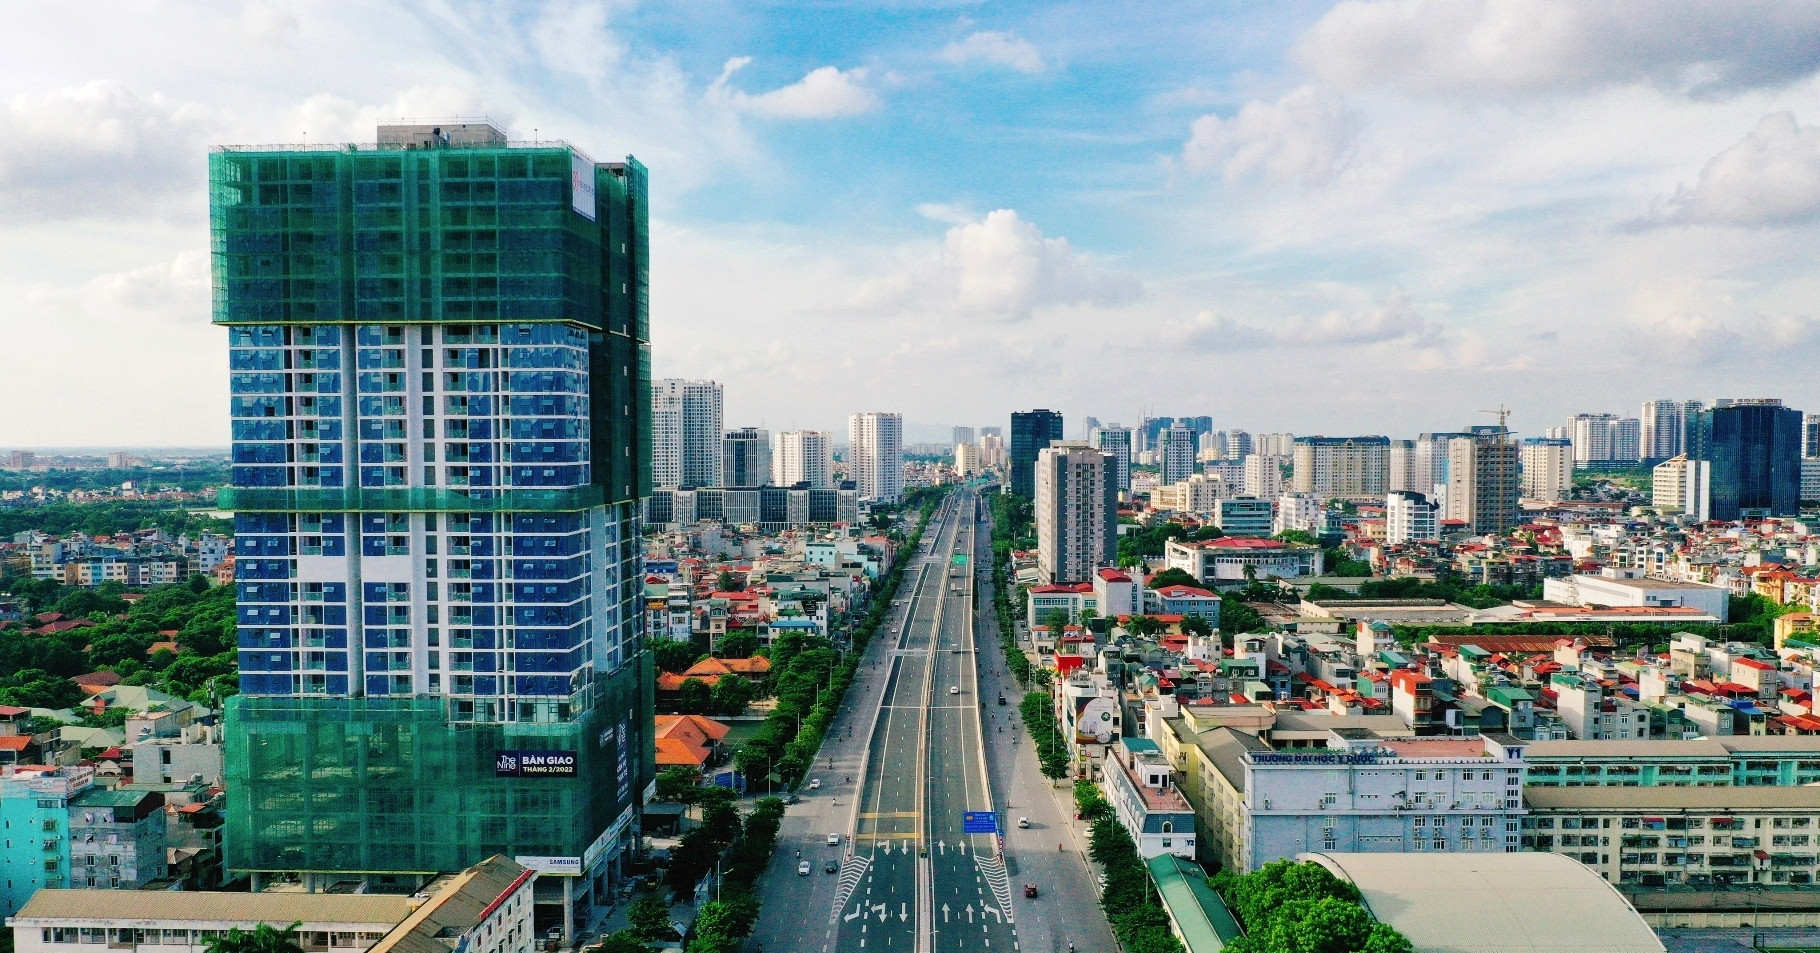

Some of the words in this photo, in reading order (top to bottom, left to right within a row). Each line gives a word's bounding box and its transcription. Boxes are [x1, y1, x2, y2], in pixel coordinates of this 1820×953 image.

[1507, 748, 1520, 758] Y1
[501, 755, 517, 763] The
[522, 755, 544, 764] BÀN
[546, 756, 574, 765] GIAO
[497, 761, 517, 770] Nine
